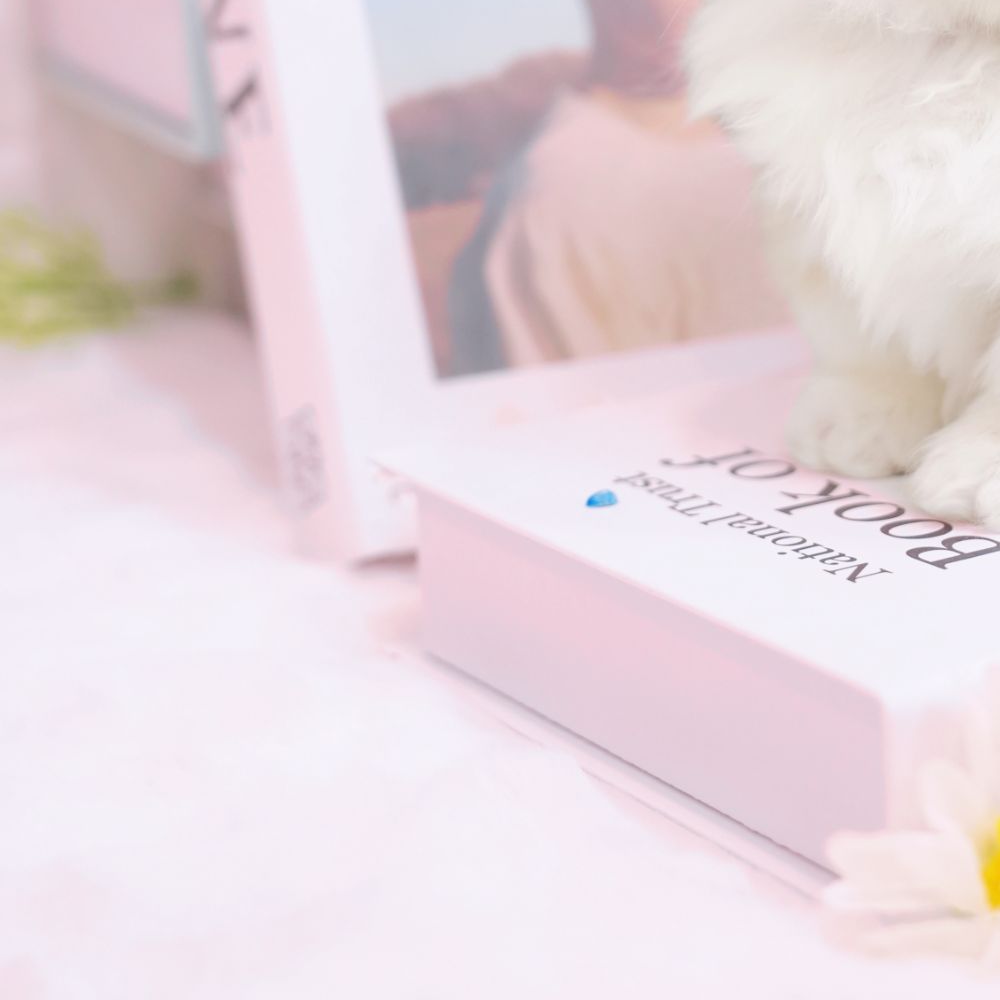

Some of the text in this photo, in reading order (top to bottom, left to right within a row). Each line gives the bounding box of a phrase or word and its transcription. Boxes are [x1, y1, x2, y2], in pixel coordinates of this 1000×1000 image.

[660, 446, 796, 480] of
[614, 471, 893, 583] National Trust
